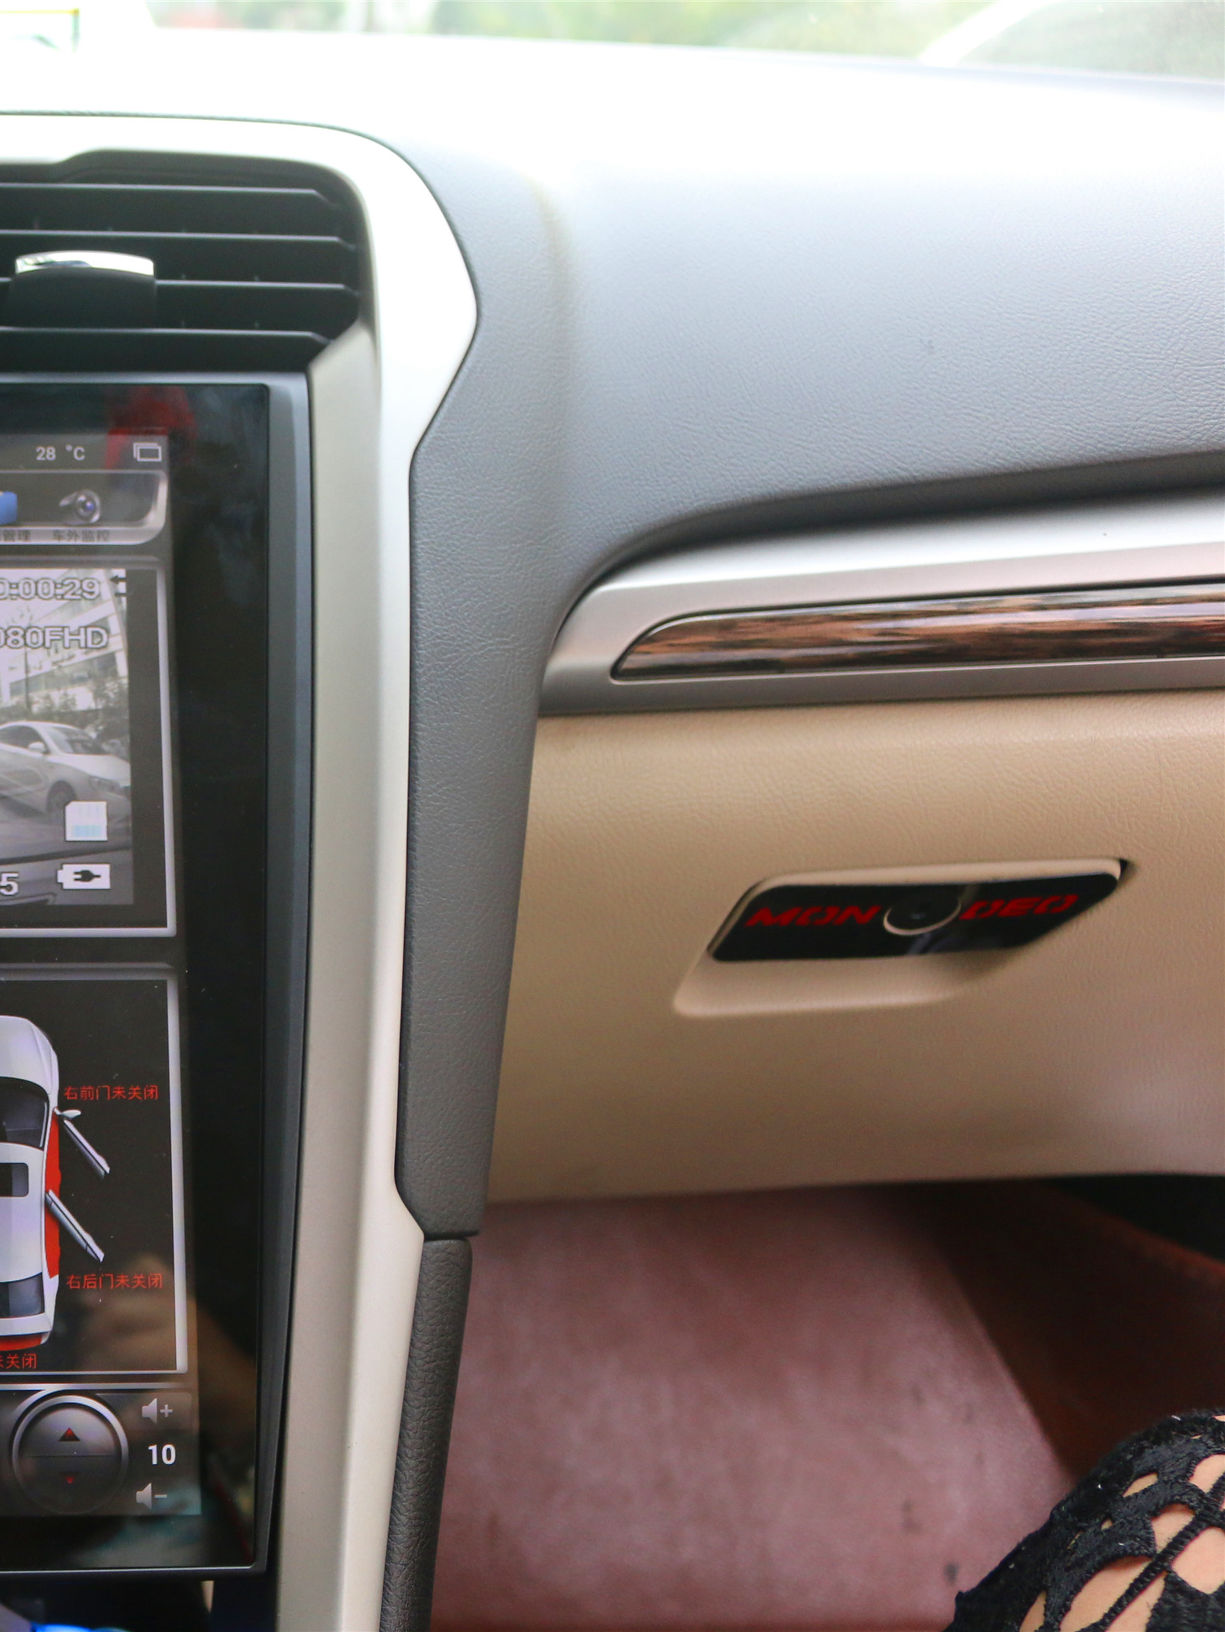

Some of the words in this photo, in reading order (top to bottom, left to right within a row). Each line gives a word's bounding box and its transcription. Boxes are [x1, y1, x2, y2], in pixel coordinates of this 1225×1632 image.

[36, 447, 56, 461] 28
[745, 906, 881, 927] MON
[63, 1085, 159, 1101] 右前门未关闭
[66, 1273, 163, 1289] 右后门未关闭
[148, 1444, 176, 1465] 10
